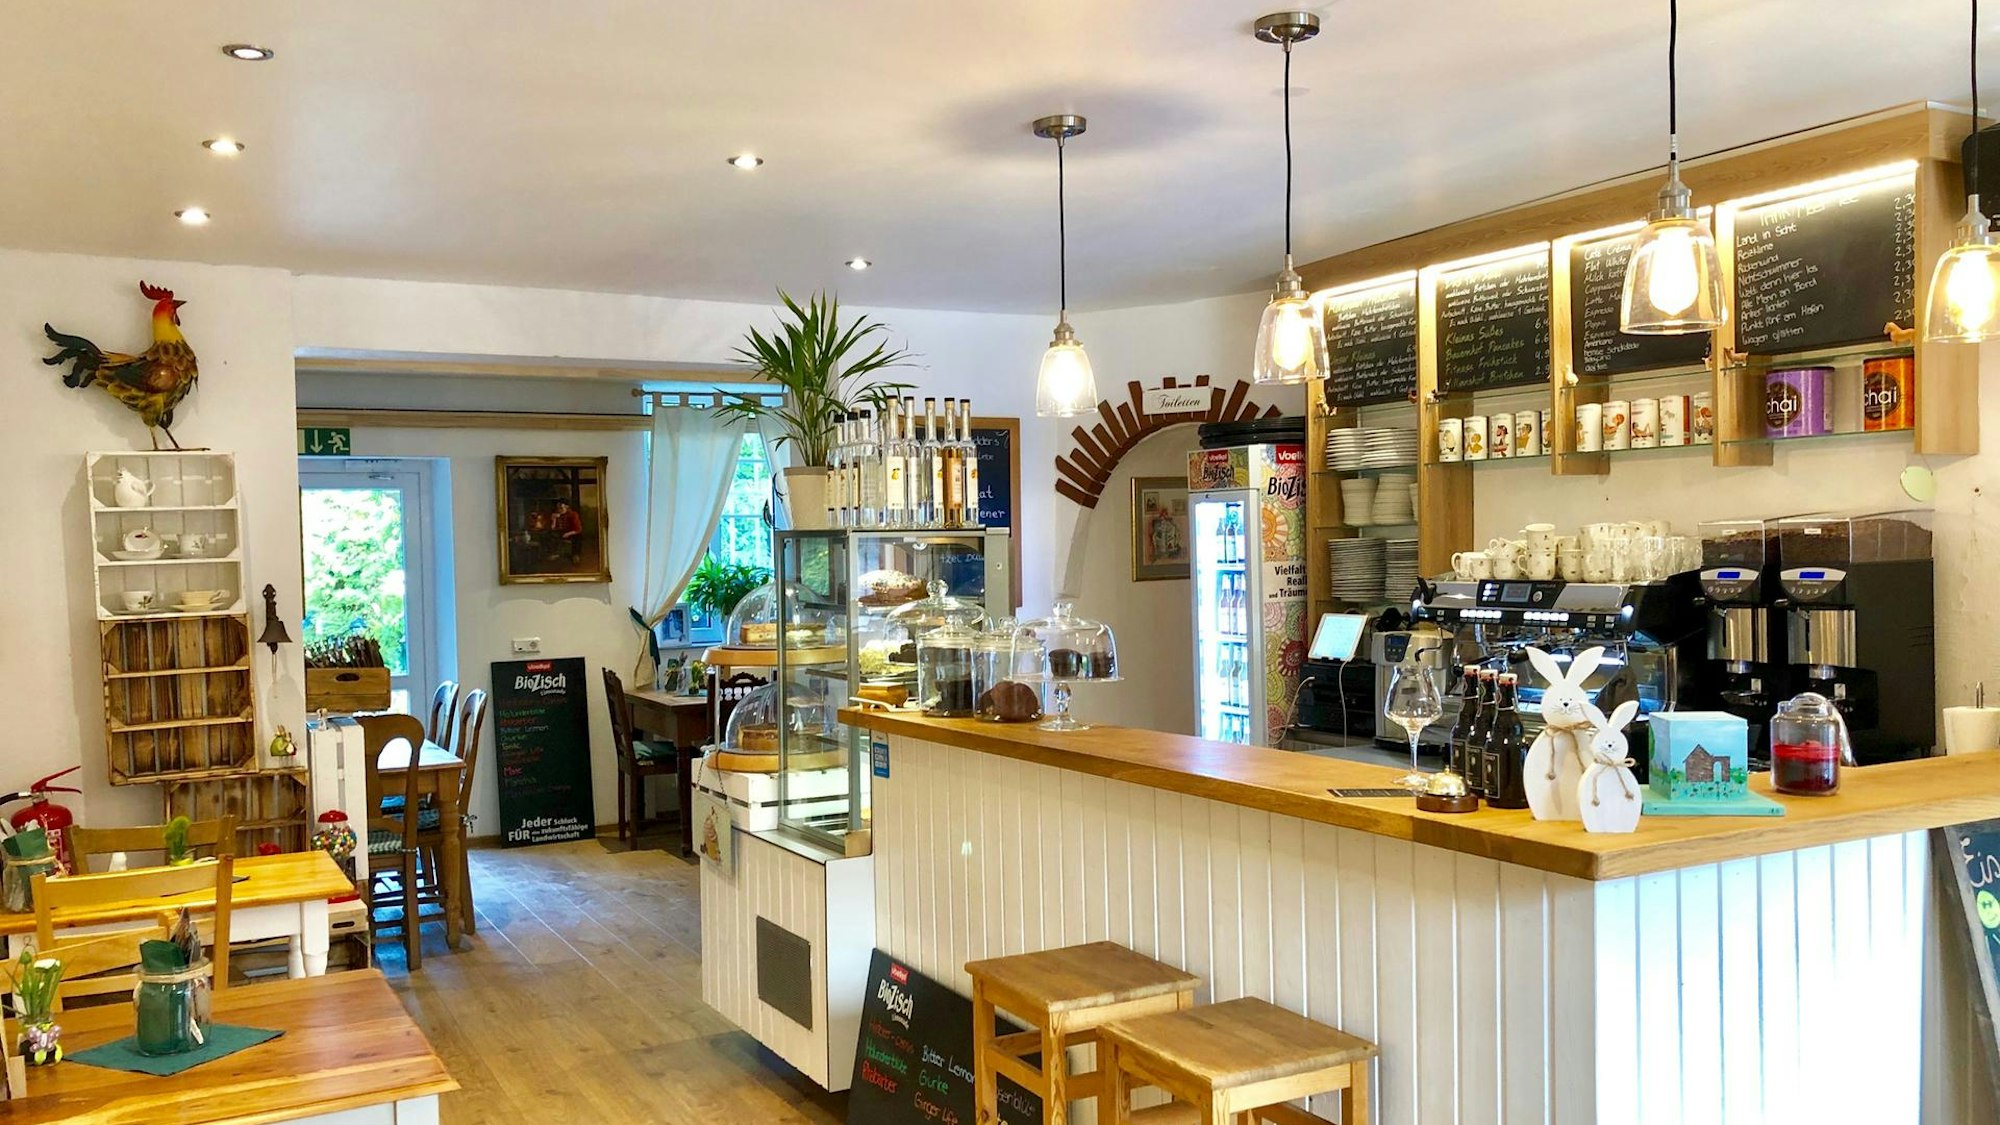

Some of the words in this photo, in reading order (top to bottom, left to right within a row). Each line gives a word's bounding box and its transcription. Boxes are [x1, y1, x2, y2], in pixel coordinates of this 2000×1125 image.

[1736, 233, 1758, 248] Land
[1762, 230, 1771, 240] in
[1775, 222, 1797, 237] Sicht
[1584, 260, 1600, 273] Flat
[1606, 256, 1628, 268] White
[1760, 277, 1782, 292] denn
[1783, 270, 1803, 283] hier
[1806, 264, 1818, 274] los
[1779, 288, 1791, 298] an
[1794, 277, 1817, 293] Bord
[1740, 307, 1763, 322] Anker
[1740, 321, 1764, 335] Punkt
[1783, 312, 1796, 322] am
[1535, 333, 1549, 344] 6.6
[1535, 349, 1549, 360] 4.9
[1535, 364, 1549, 376] 2.9
[1159, 394, 1201, 409] Toiletten
[1278, 450, 1306, 461] Voelk
[1202, 464, 1235, 482] BioZisch
[979, 509, 1006, 519] ener
[1274, 564, 1306, 575] Vielfalt
[514, 673, 566, 692] BioZisch
[521, 816, 552, 829] Jeder
[508, 828, 530, 841] FÜR
[532, 831, 580, 842] Landwirtschaft
[877, 979, 914, 1020] BioZisch
[919, 1069, 949, 1095] Gurke
